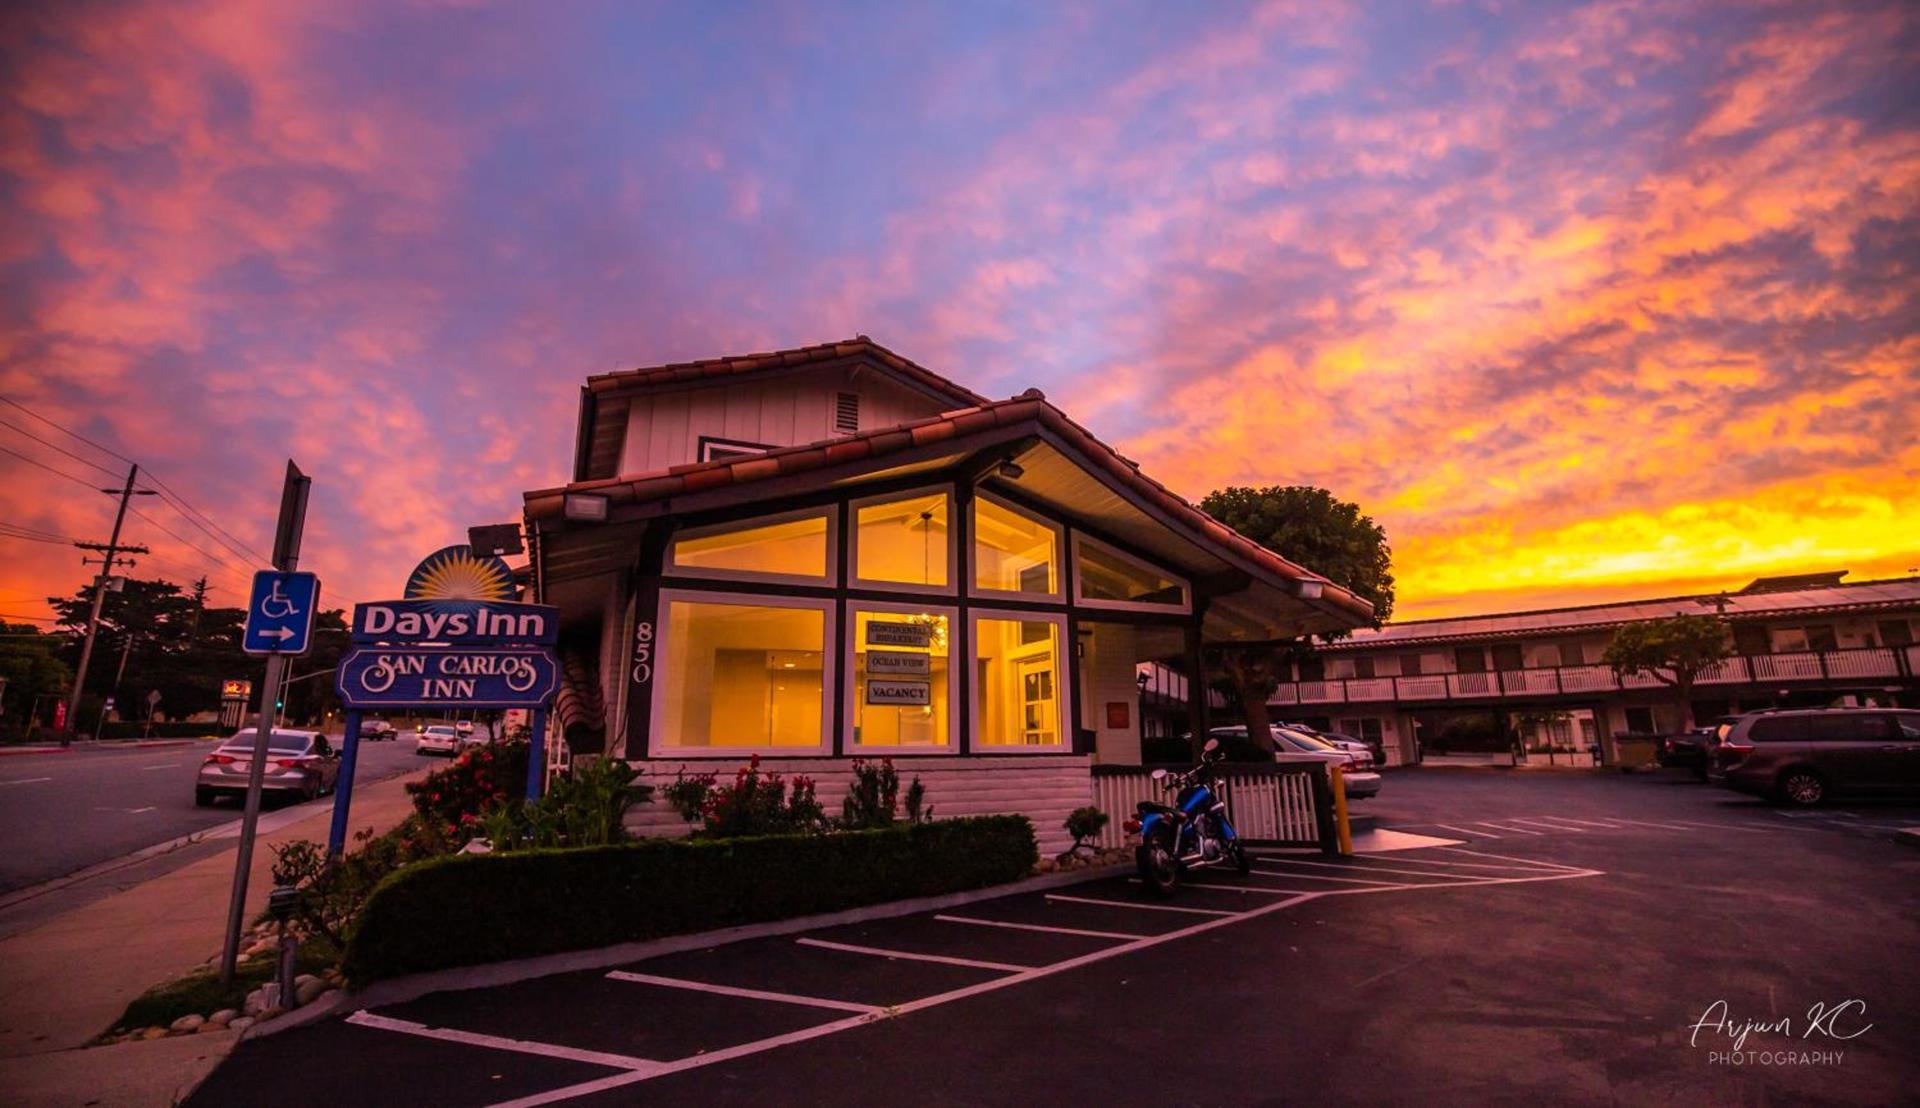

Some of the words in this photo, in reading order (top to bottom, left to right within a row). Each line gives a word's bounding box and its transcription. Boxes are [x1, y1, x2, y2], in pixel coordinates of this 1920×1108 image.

[364, 606, 469, 639] Days
[476, 608, 544, 636] Inn
[633, 622, 652, 683] 850
[872, 656, 900, 667] OCEAN
[361, 655, 427, 692] SAN
[439, 656, 537, 692] CARLOS
[421, 679, 476, 698] INN
[872, 686, 926, 699] VACANCY
